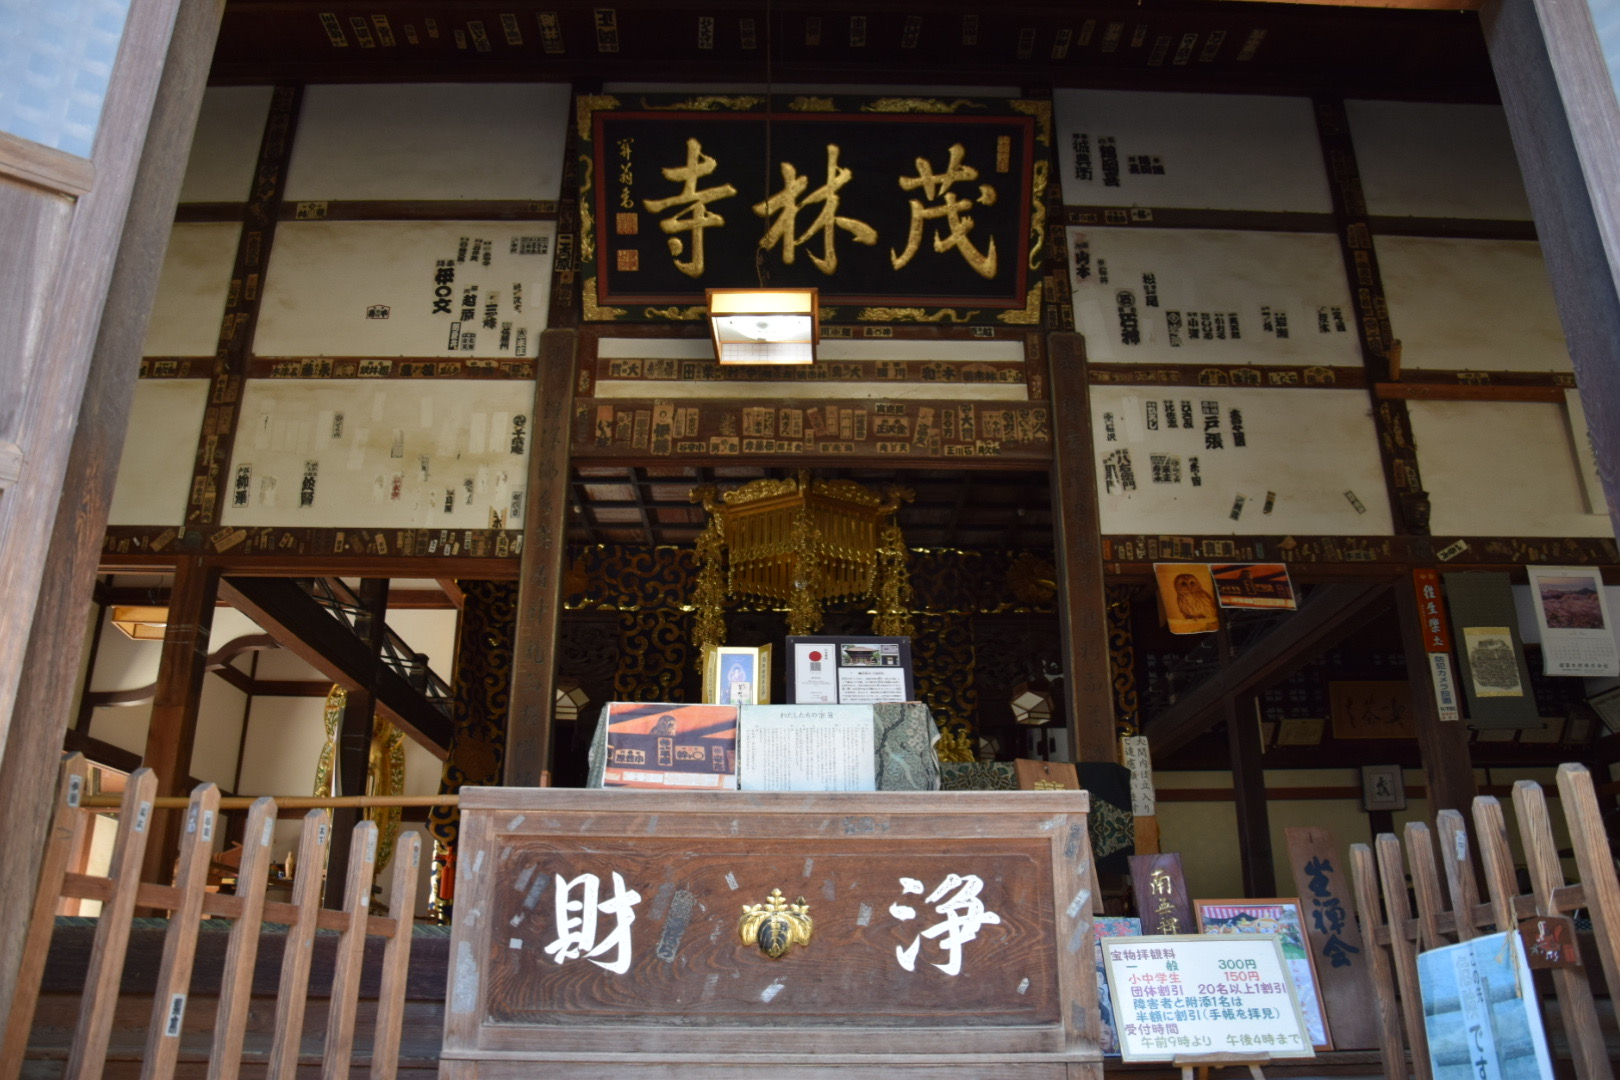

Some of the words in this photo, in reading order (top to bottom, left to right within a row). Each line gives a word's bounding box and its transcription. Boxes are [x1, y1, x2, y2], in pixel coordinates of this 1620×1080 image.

[643, 137, 998, 279] 茂林寺
[1110, 948, 1176, 961] 宝物拝観料
[1218, 959, 1257, 970] 300円
[1128, 973, 1182, 984] 小中学生
[1224, 971, 1260, 982] 150円
[1130, 985, 1184, 997] 団体割引
[1198, 983, 1287, 995] 20名以上1割引
[1133, 997, 1244, 1010] 障害者と附添1名は
[1124, 1024, 1179, 1036] 受付時間
[1141, 1034, 1212, 1048] 午前9時より
[1226, 1033, 1300, 1046] 午後4時まで
